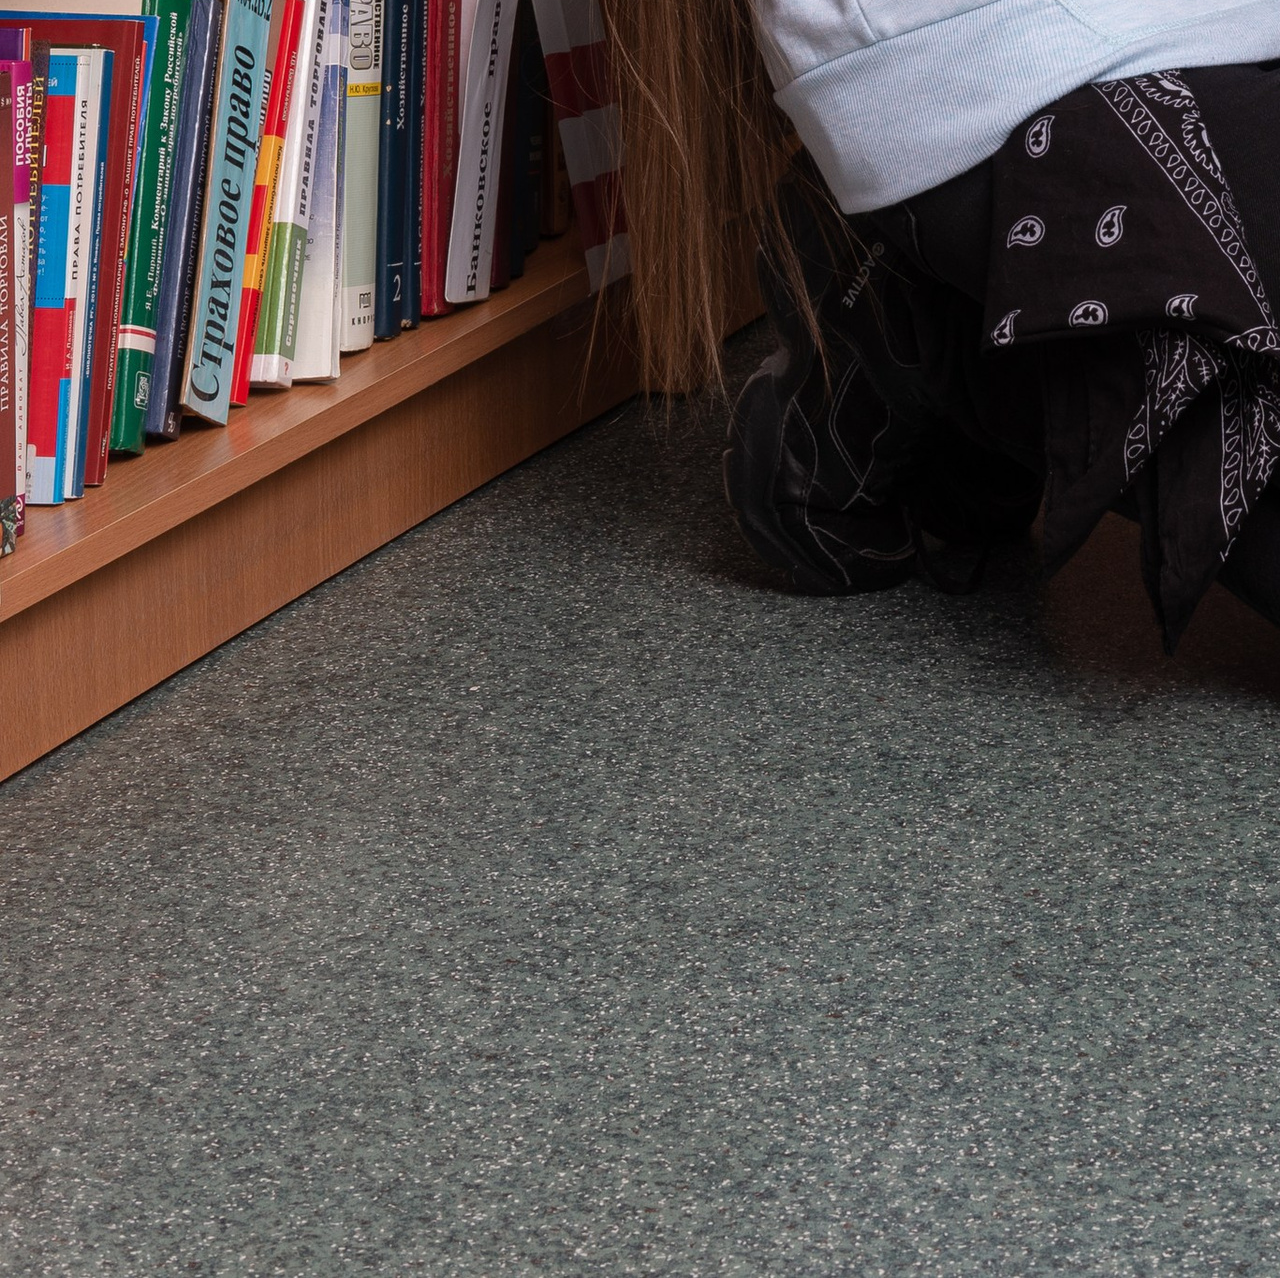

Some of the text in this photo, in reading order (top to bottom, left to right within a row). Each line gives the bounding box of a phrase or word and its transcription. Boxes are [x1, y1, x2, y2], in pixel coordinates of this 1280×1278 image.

[163, 12, 178, 83] Российской
[396, 3, 410, 130] Хозяйственное
[442, 1, 457, 180] Хозяйственное
[15, 85, 26, 167] ПОСОБИЯ
[152, 31, 184, 297] Федерации защите прав потребителей»
[157, 134, 168, 143] к
[158, 87, 173, 131] Закону
[71, 99, 88, 281] ПРАВА ПОТРЕБИТЕЛЯ
[150, 147, 167, 231] Комментарий
[190, 44, 256, 403] Страховое право
[256, 160, 281, 291] потребителю защитить свои
[466, 102, 493, 296] Банковское
[0, 214, 9, 412] ПРАВИЛА ТОРГОВЛИ
[108, 123, 136, 390] ПОСТАТЕЙНЫЙ КОММЕНТАРИЙ ЗАКОНУ РФ ЗАЩИТЕ ПРАВ
[145, 287, 156, 311] Я.Е.
[285, 238, 302, 347] Справочник
[392, 275, 402, 302] 2
[177, 287, 193, 358] ПРАВОВОЕ
